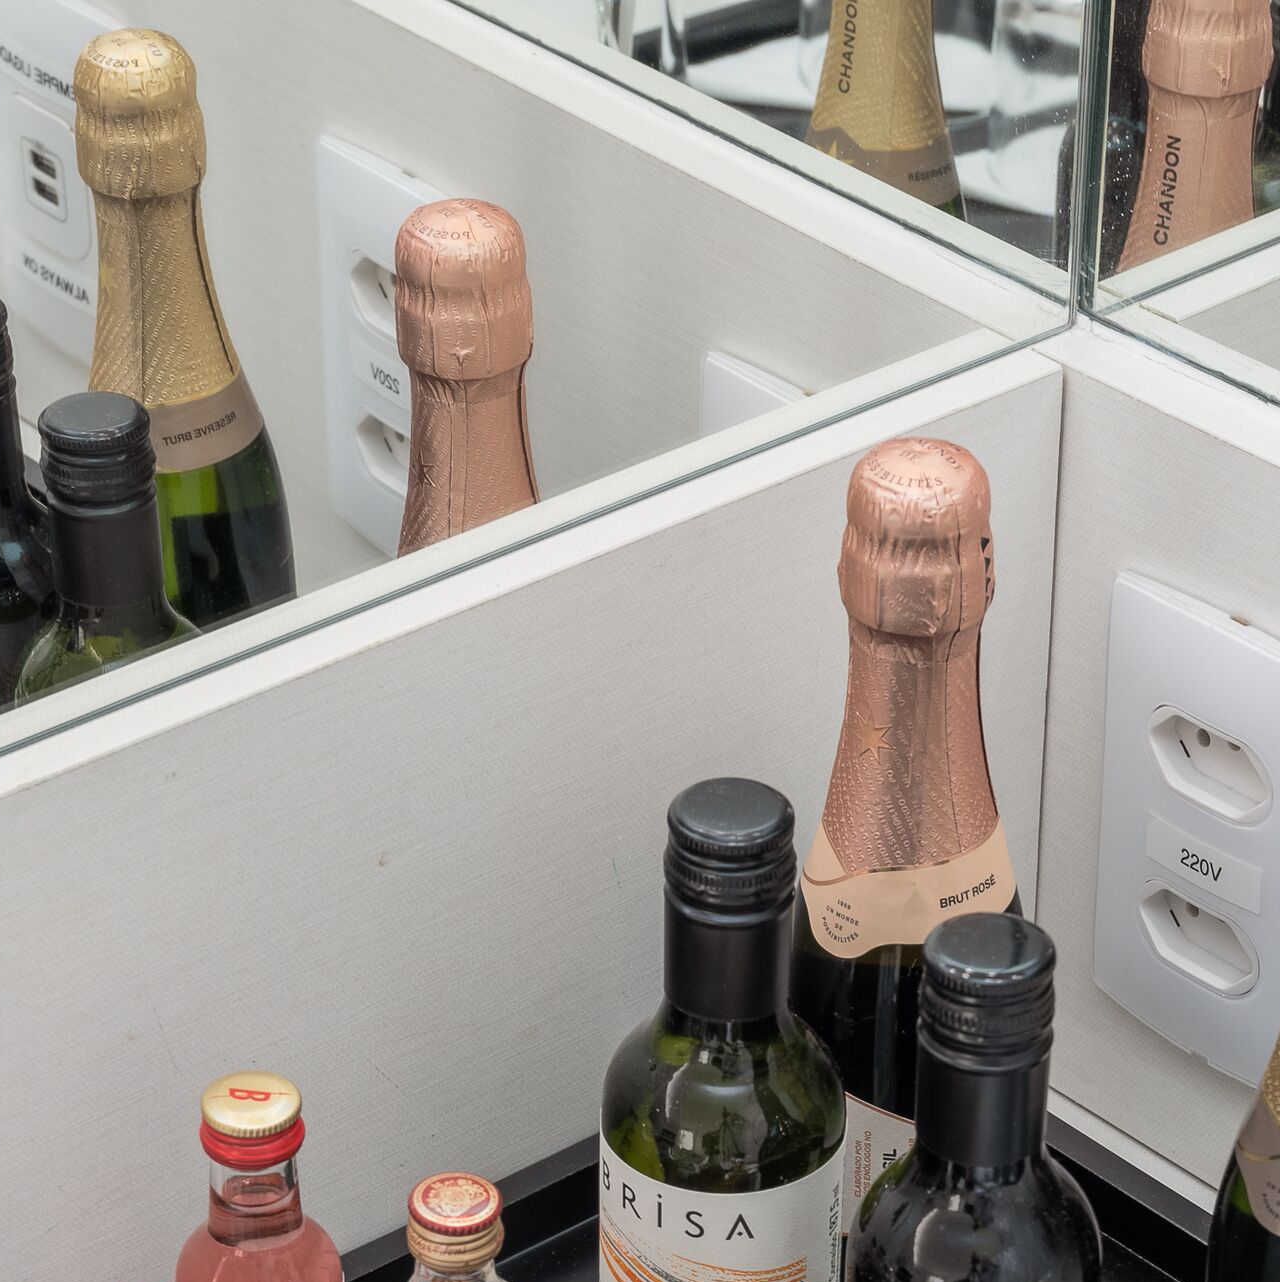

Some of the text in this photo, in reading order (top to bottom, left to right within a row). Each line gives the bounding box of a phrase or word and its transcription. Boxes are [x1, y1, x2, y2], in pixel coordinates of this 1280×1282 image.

[838, 0, 858, 94] CHANDO
[1153, 135, 1182, 246] CHANDON
[1180, 848, 1223, 882] 220V
[939, 873, 996, 909] BRUT ROSÉ
[835, 910, 859, 926] MONDE
